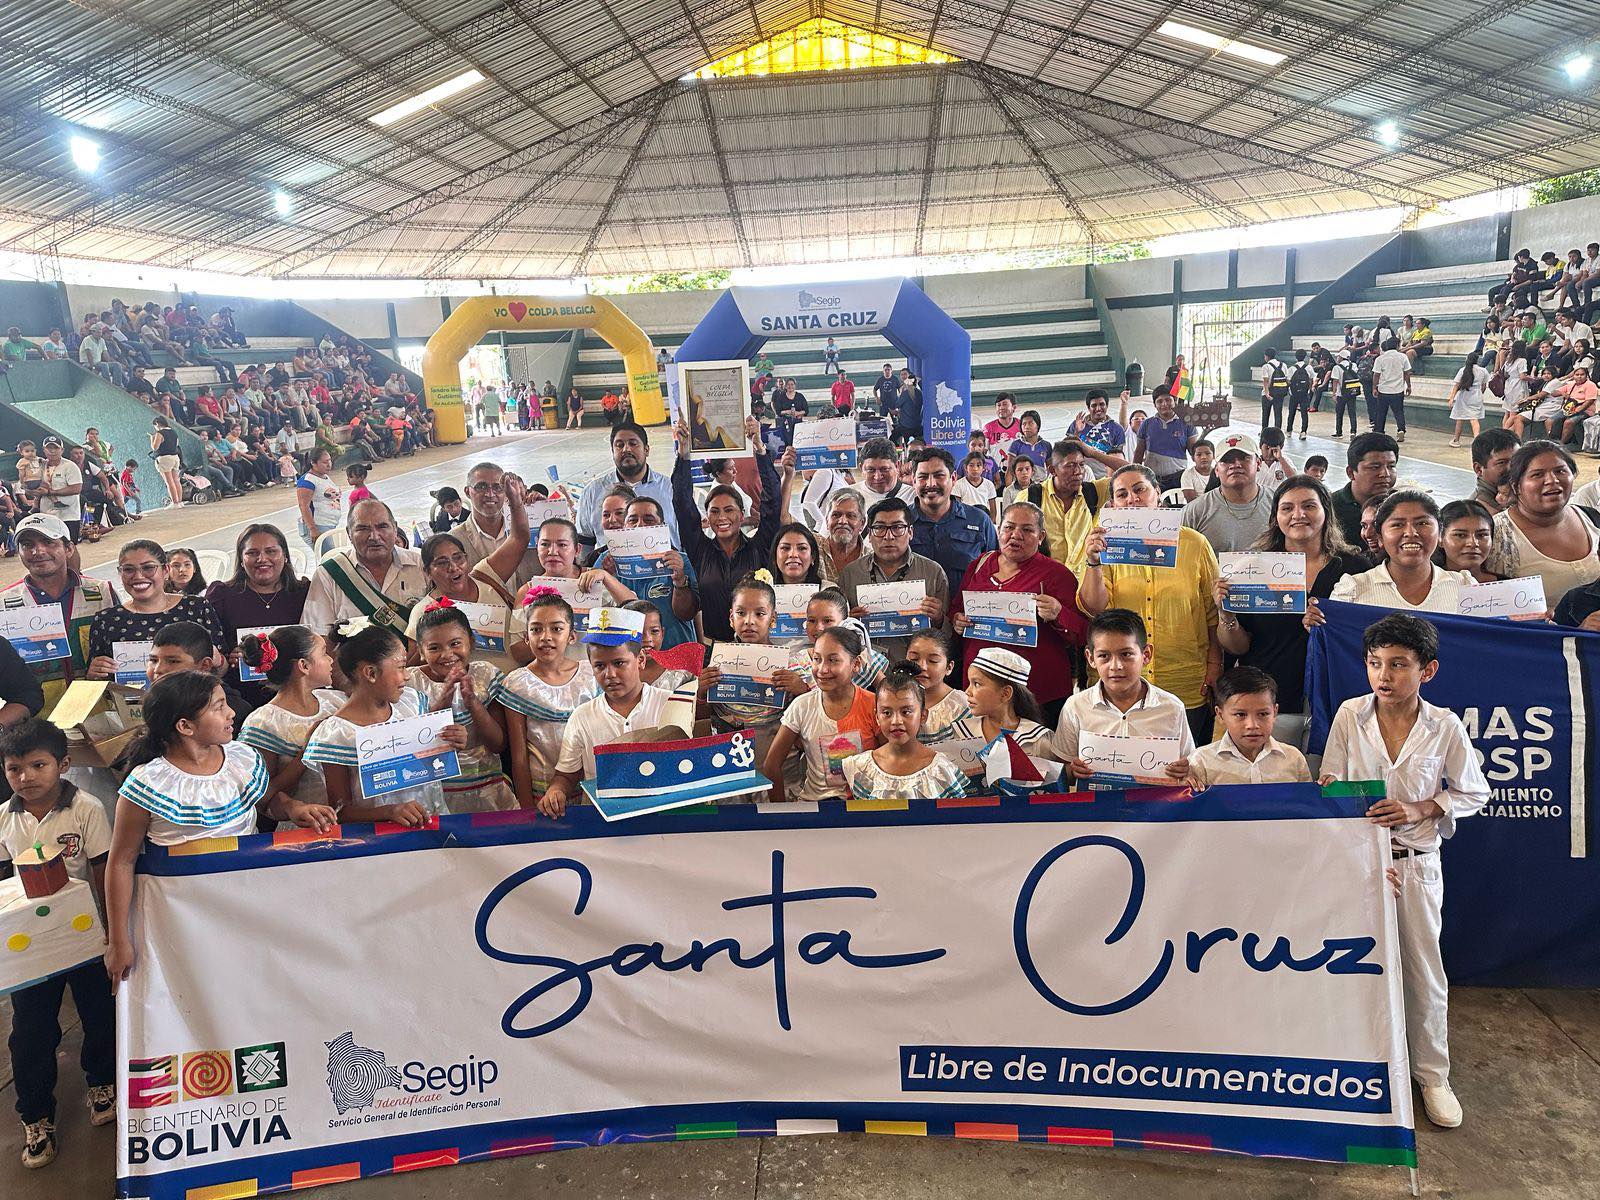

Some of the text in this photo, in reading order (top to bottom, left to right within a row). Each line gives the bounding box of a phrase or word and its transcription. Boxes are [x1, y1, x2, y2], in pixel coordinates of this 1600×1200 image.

[816, 296, 841, 307] Segip
[494, 304, 597, 317] YO COLPA BELGICA
[761, 311, 878, 331] SANTA CRUZ
[709, 383, 731, 391] COLPA
[930, 416, 966, 429] Bolivia
[930, 430, 967, 440] Libre de
[1102, 518, 1178, 534] Santa Cruz
[1222, 563, 1304, 582] Santa Cruz
[860, 594, 895, 609] Santa
[966, 599, 1004, 614] Santa
[1460, 591, 1544, 614] Santa Cruz
[116, 652, 149, 668] Sant
[713, 654, 750, 670] Santa
[360, 736, 411, 760] Santa
[418, 727, 440, 744] Cr
[1081, 746, 1133, 768] Santa
[374, 780, 398, 790] BOLIVIA
[1488, 788, 1553, 802] MIENTO
[1479, 805, 1562, 818] CIALISMO
[475, 835, 1384, 1038] Santa Cruz
[402, 1054, 498, 1096] Segip
[907, 1052, 1384, 1100] Libre de Indocumentados
[128, 1097, 287, 1134] BICENTENARIO DE
[328, 1098, 501, 1128] Servicio General de Identificación Personal
[128, 1115, 292, 1165] BOLIVIA
